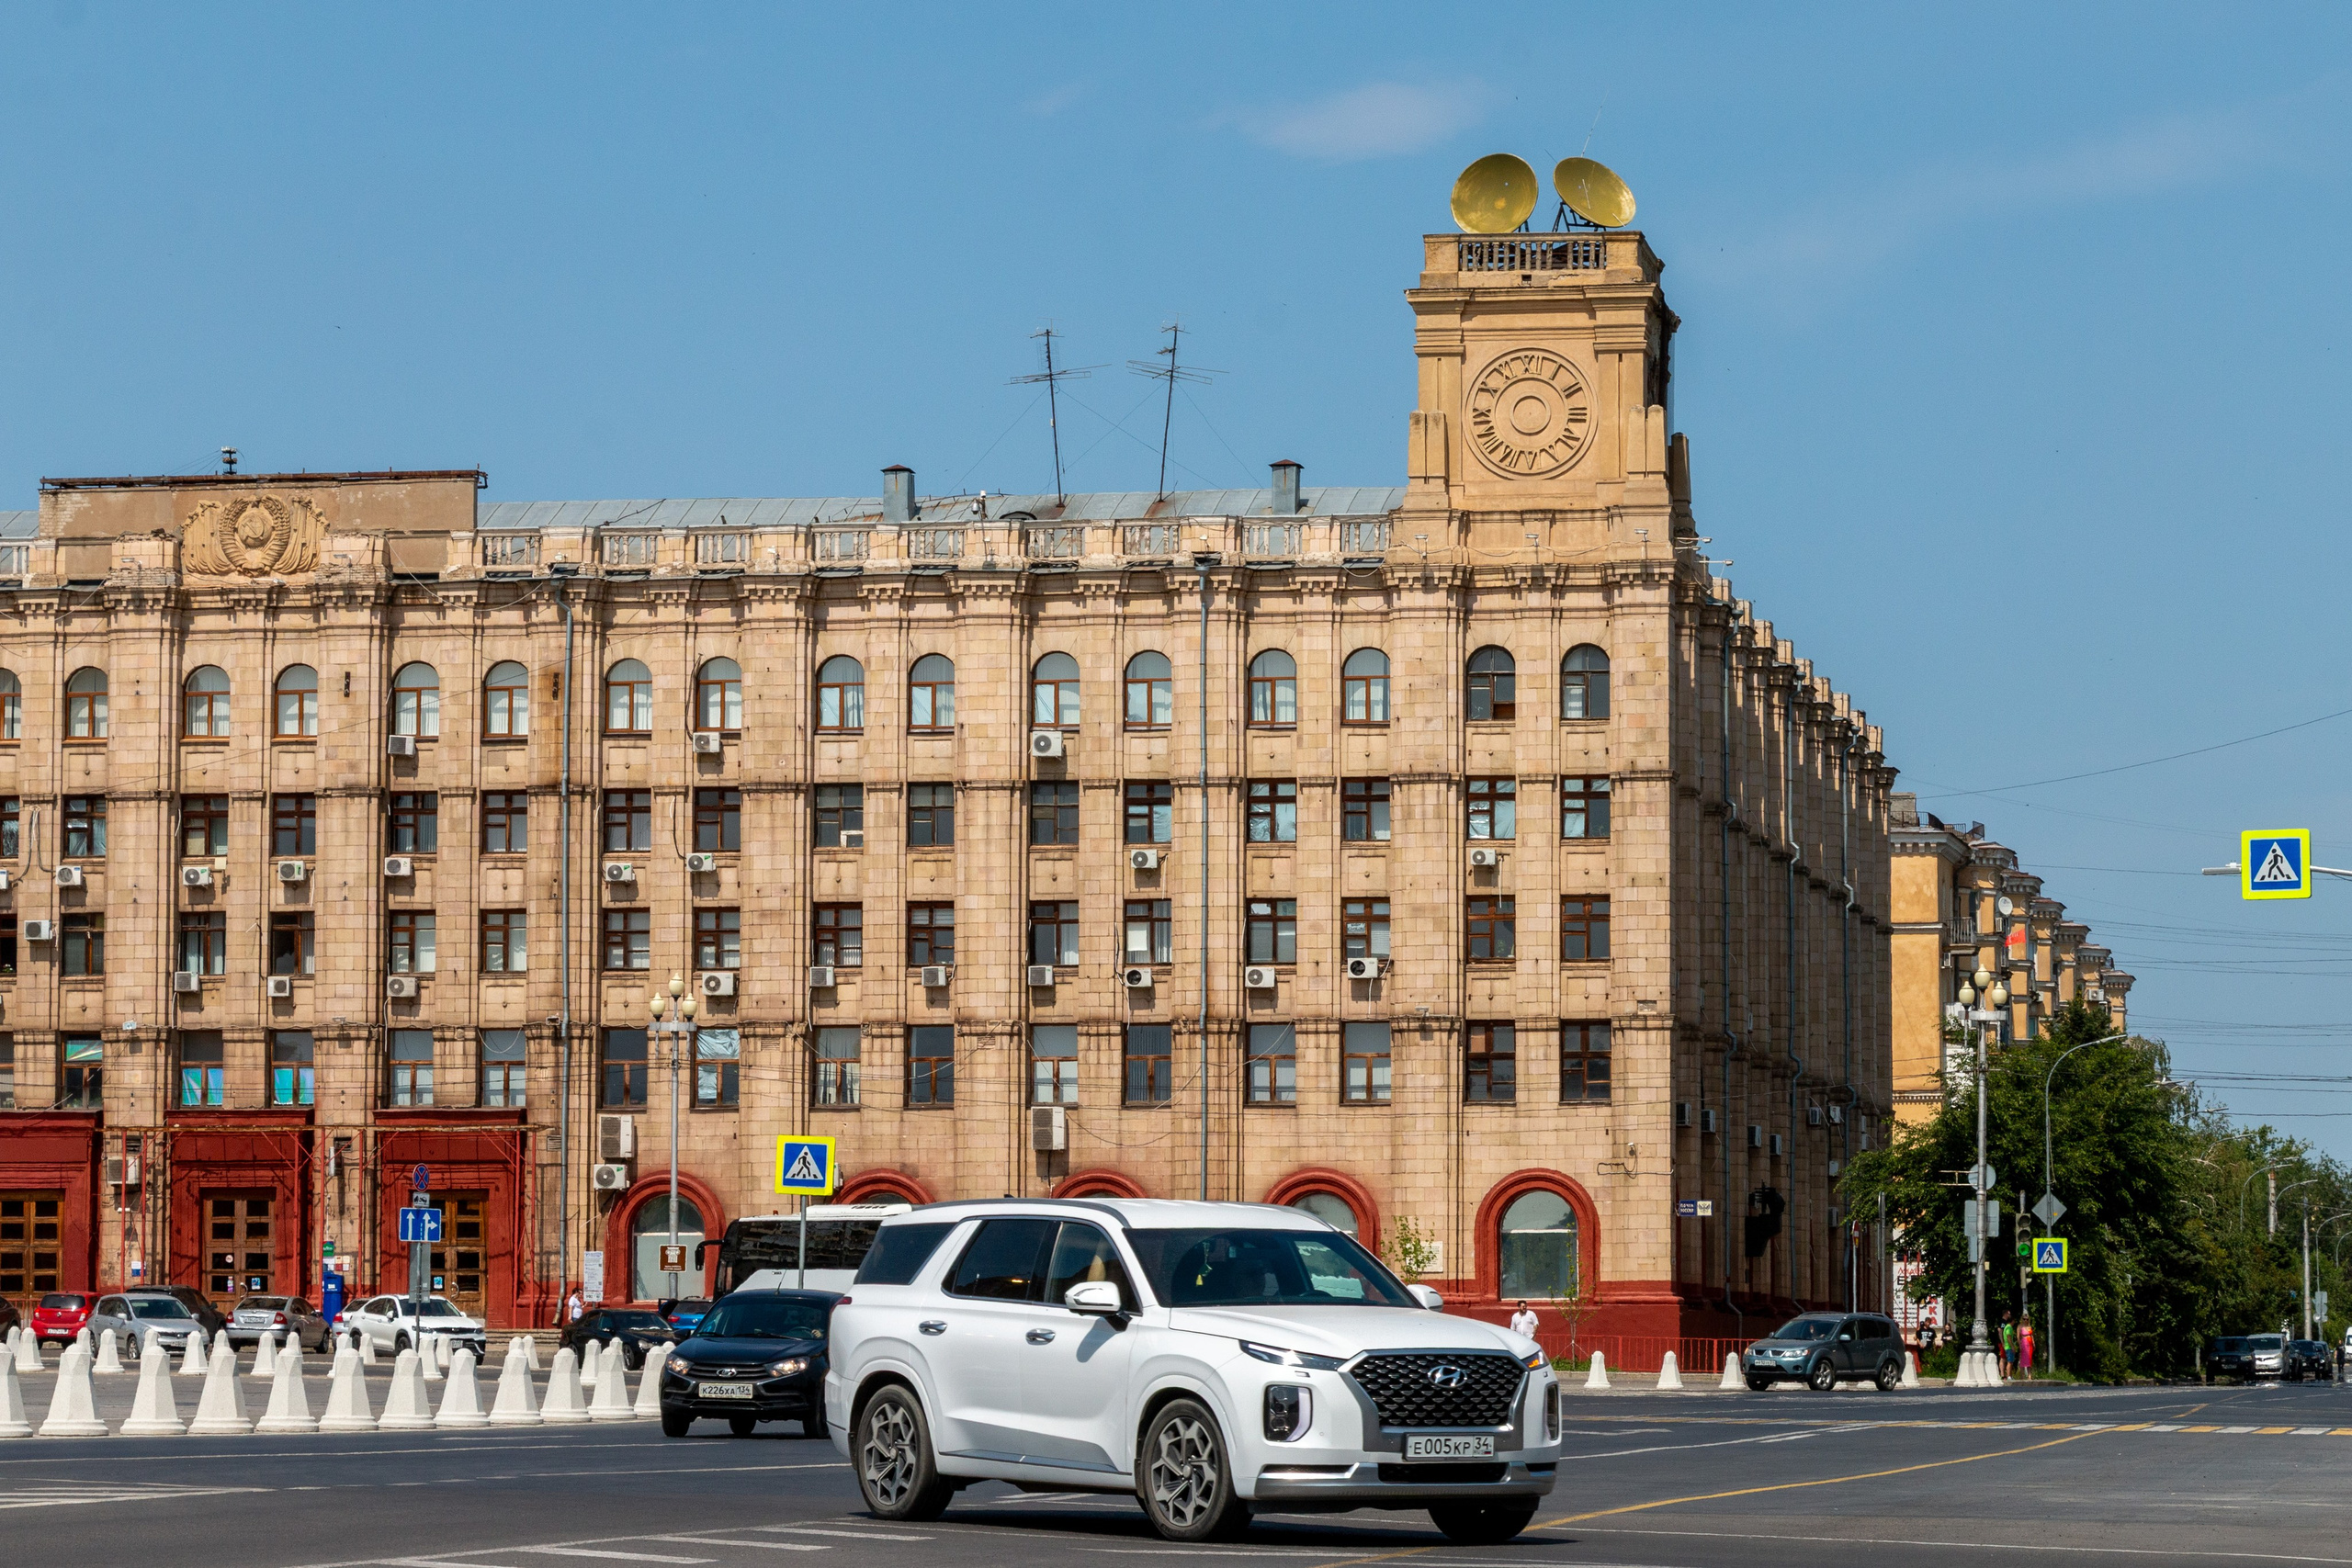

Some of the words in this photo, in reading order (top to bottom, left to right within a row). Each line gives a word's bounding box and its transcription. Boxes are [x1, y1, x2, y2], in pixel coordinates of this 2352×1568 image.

[1520, 355, 1544, 376] XII
[737, 1385, 750, 1393] 134
[1414, 1438, 1471, 1454] Е005КР
[1475, 1438, 1488, 1450] 34
